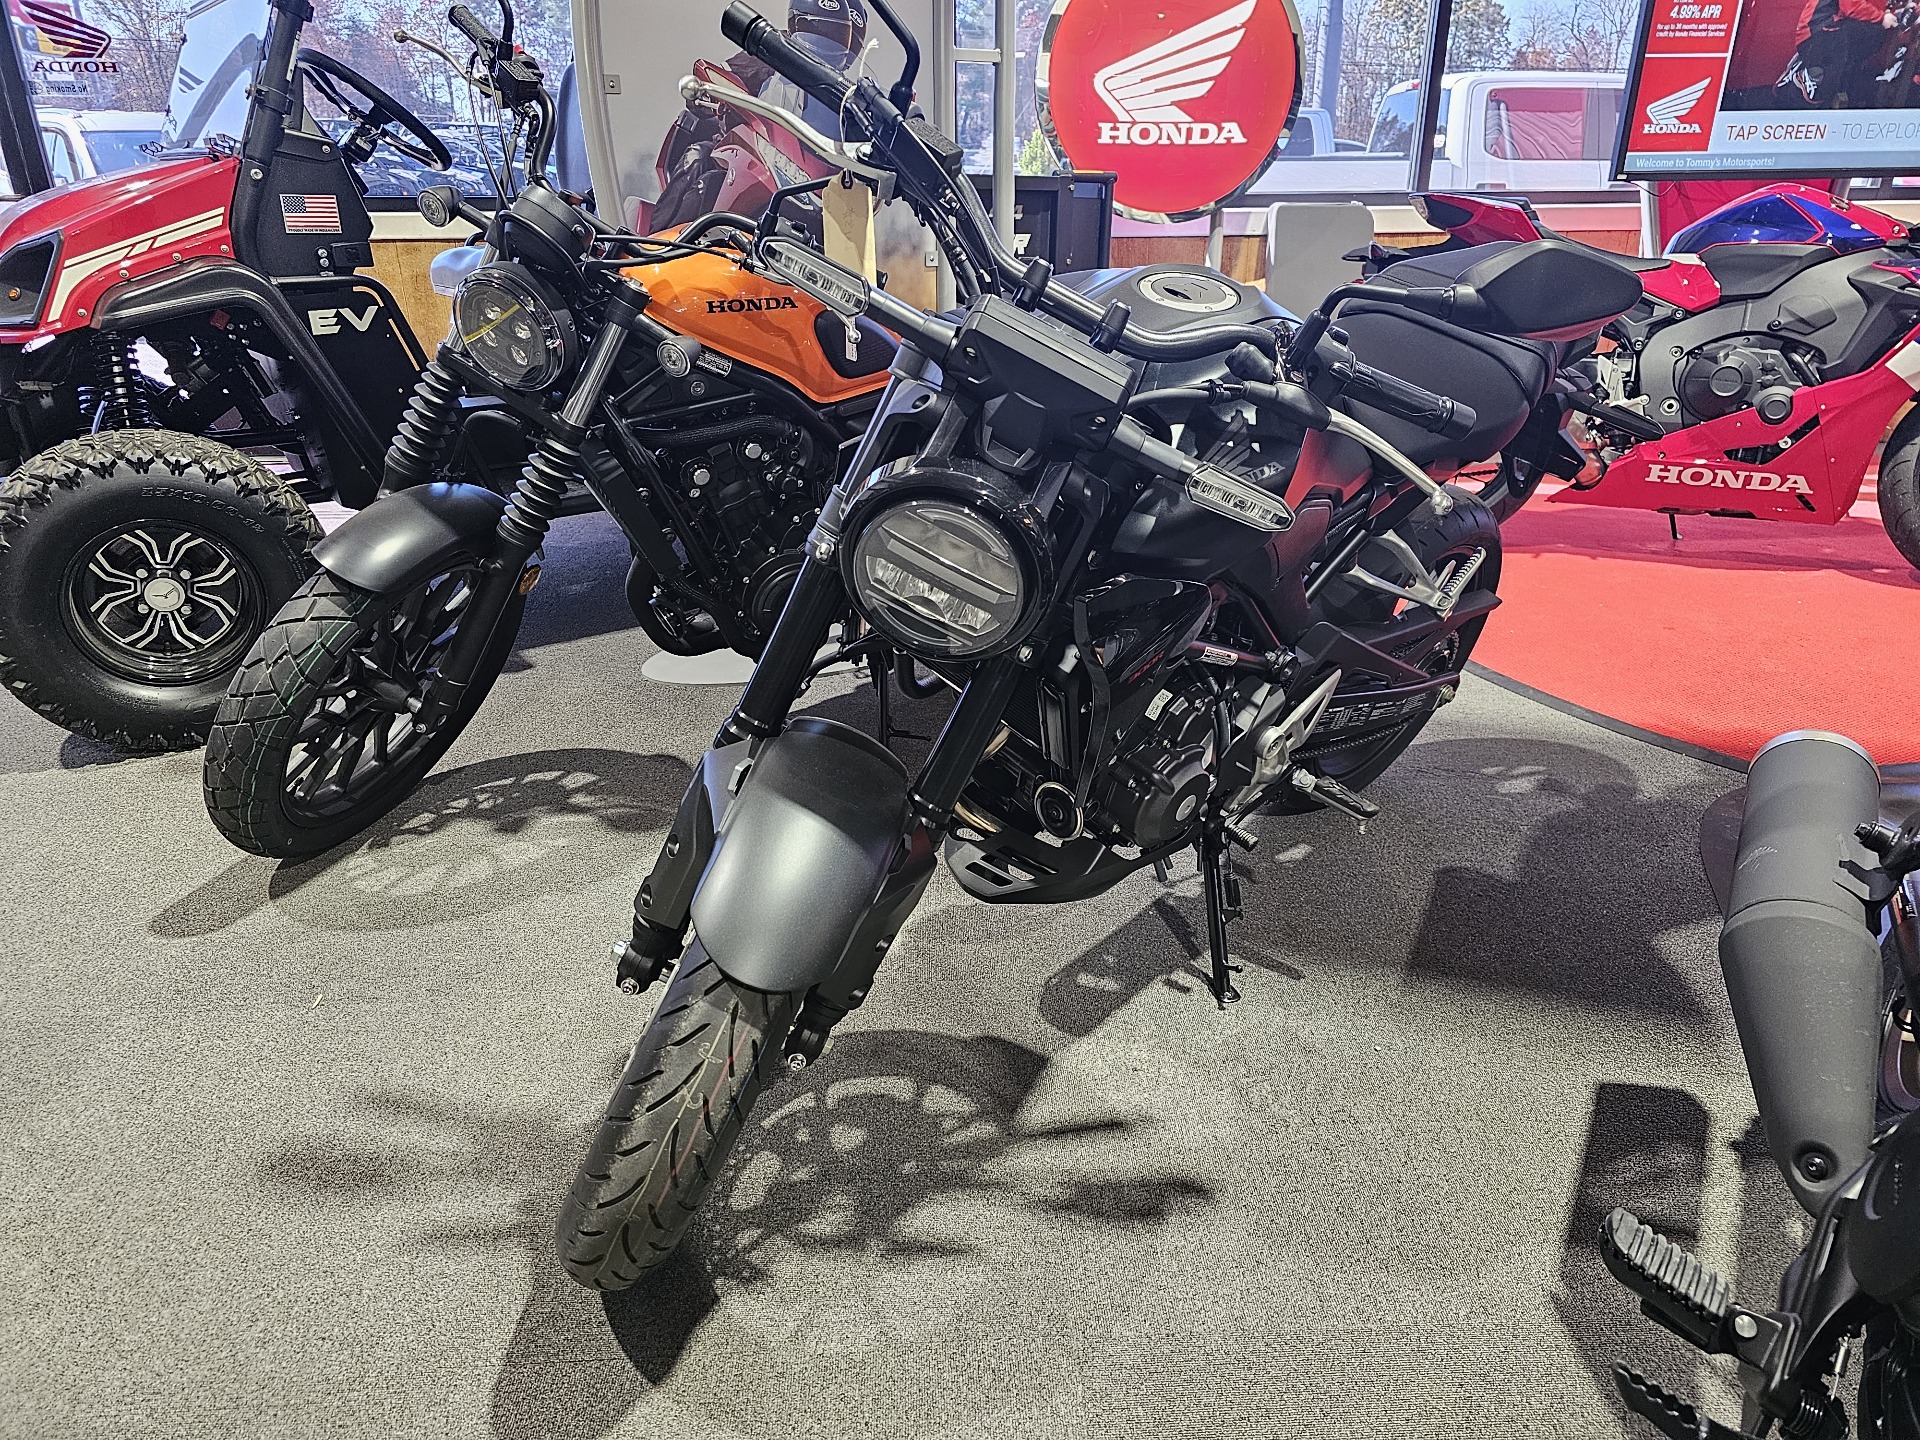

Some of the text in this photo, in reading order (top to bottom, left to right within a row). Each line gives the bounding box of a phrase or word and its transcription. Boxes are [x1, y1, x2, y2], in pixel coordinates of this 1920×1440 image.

[1670, 5, 1722, 18] 4.99% APR
[1708, 23, 1728, 31] approved
[1097, 122, 1248, 145] HONDA
[1643, 123, 1702, 134] HONDA
[1727, 125, 1757, 140] TAP
[1762, 124, 1827, 140] SCREEN
[1842, 123, 1863, 139] TO
[1636, 156, 1775, 168] Welcome to Tommy's Motorsports!
[706, 296, 798, 313] HONDA
[308, 306, 378, 335] EV
[1240, 461, 1286, 484] NDA
[1645, 464, 1813, 494] HONDA
